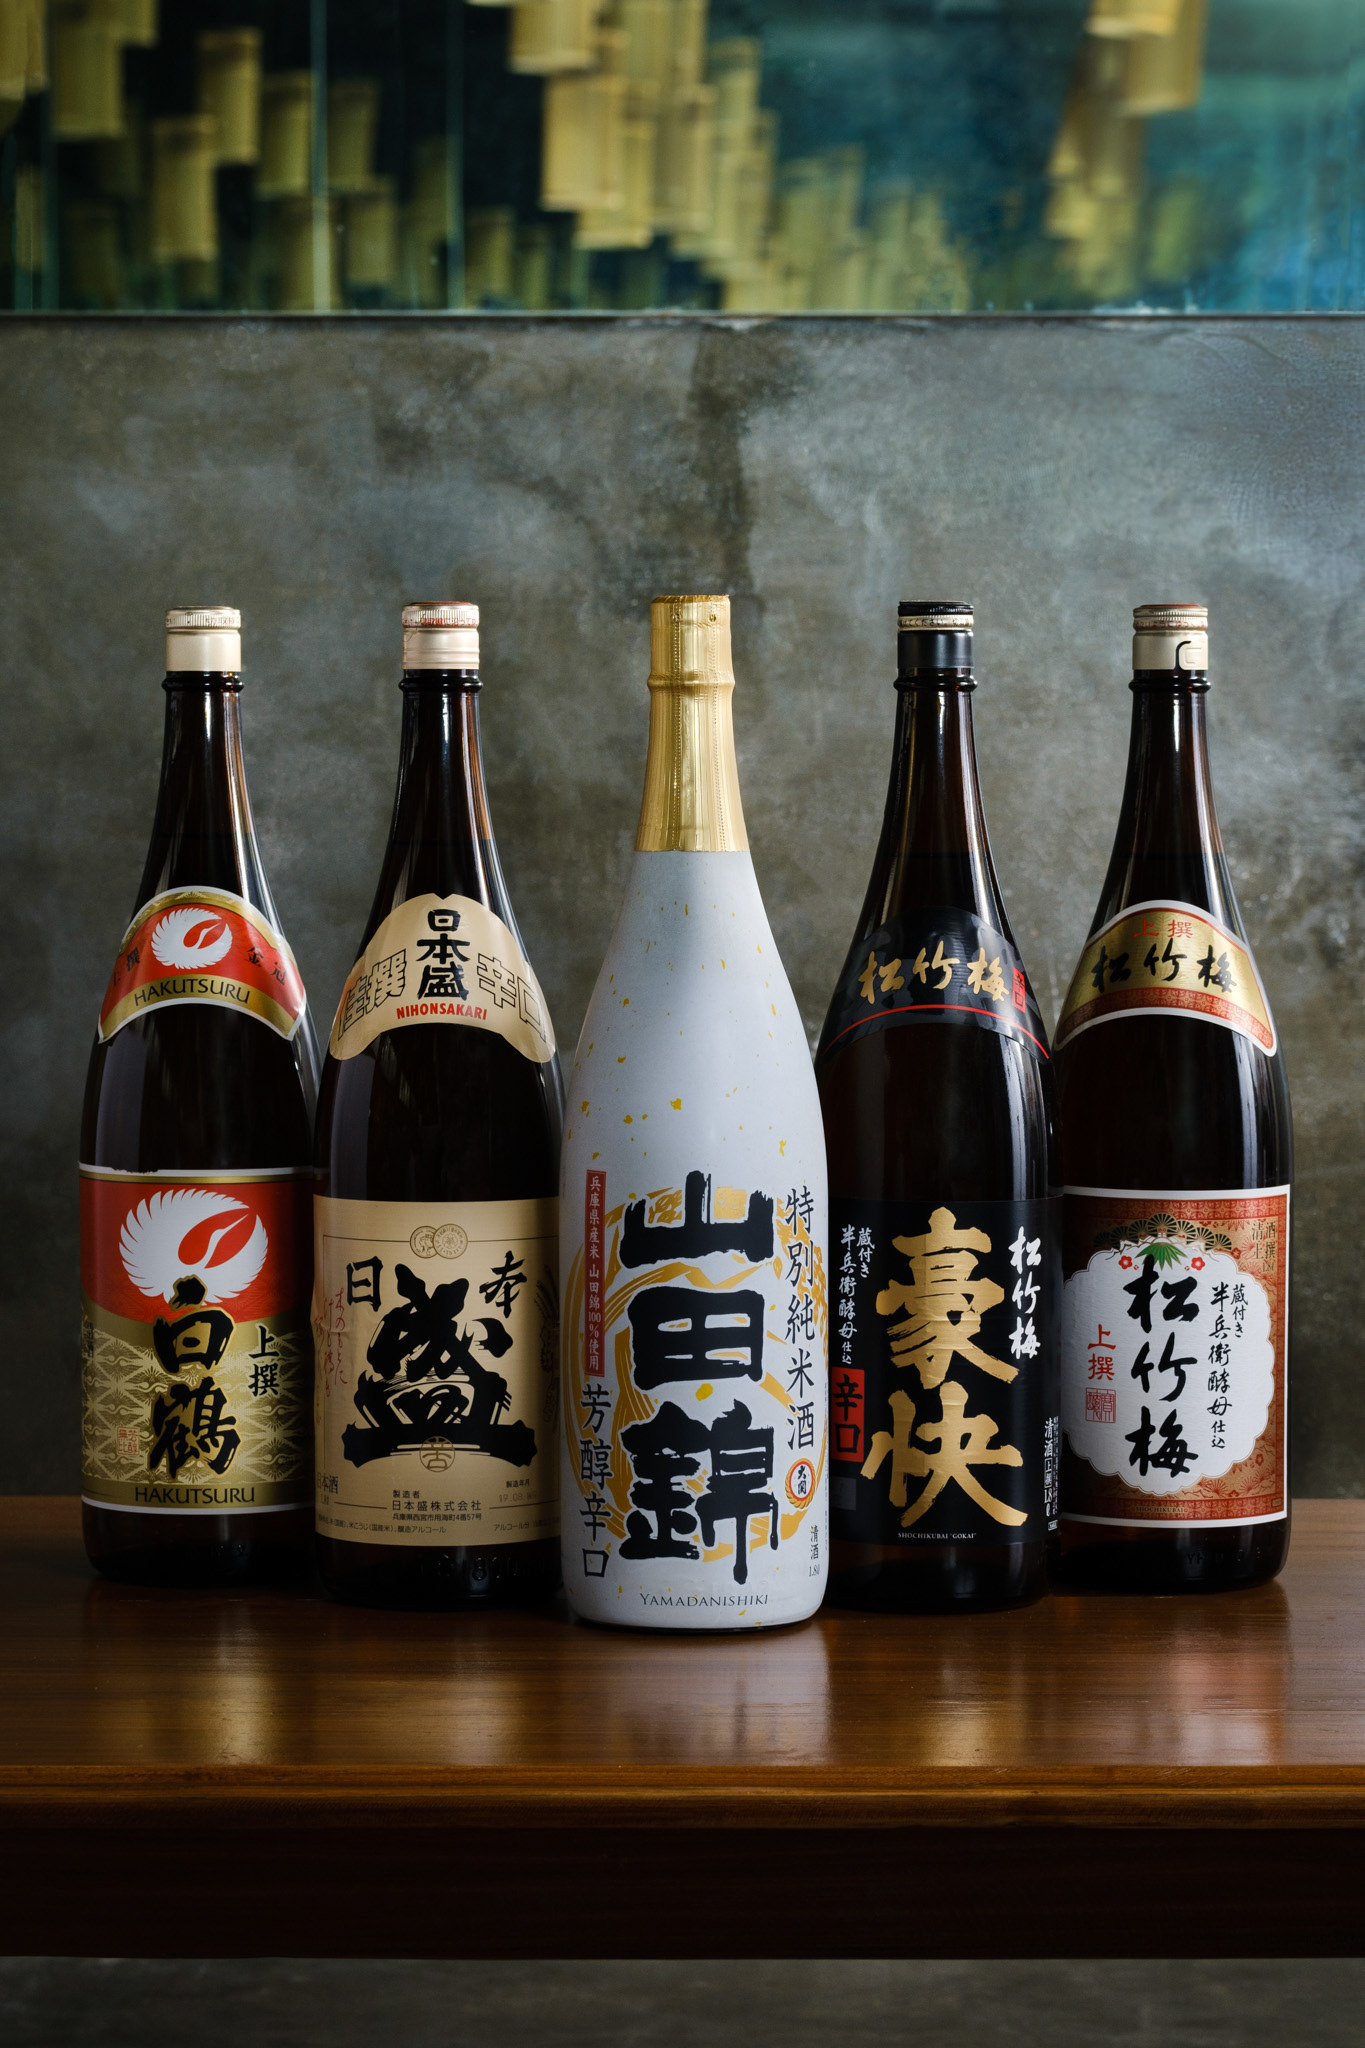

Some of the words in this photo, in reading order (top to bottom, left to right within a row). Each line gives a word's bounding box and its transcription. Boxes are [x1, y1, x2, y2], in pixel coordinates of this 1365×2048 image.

[416, 909, 470, 1001] 日本盛
[1133, 918, 1193, 940] 上撰
[134, 978, 251, 1006] HAKUTSURU
[858, 940, 1010, 1004] 松竹梅
[1090, 938, 1237, 994] 松竹梅
[396, 1002, 487, 1020] NIHONSAKARI
[856, 1227, 875, 1278] 蔵付き
[785, 1185, 815, 1451] 特別純米酒
[1008, 1226, 1042, 1360] 松竹梅
[1230, 1284, 1248, 1338] 蔵付き
[150, 1274, 241, 1479] 白鶴
[248, 1324, 281, 1398] 上撰
[619, 1170, 779, 1585] 山田錦
[860, 1206, 1029, 1528] 豪快
[1087, 1323, 1117, 1382] 上撰
[1123, 1254, 1200, 1479] 松竹梅
[1207, 1281, 1233, 1449] 半兵衛酵母仕込
[832, 1373, 863, 1454] 辛口
[135, 1486, 255, 1504] HAKUTSURU
[392, 1499, 482, 1511] 日本盛株式会社
[580, 1383, 613, 1578] 芳醇辛口
[897, 1532, 948, 1540] SHOCHIKUBAI
[640, 1593, 769, 1607] YAMADANISHIKI
